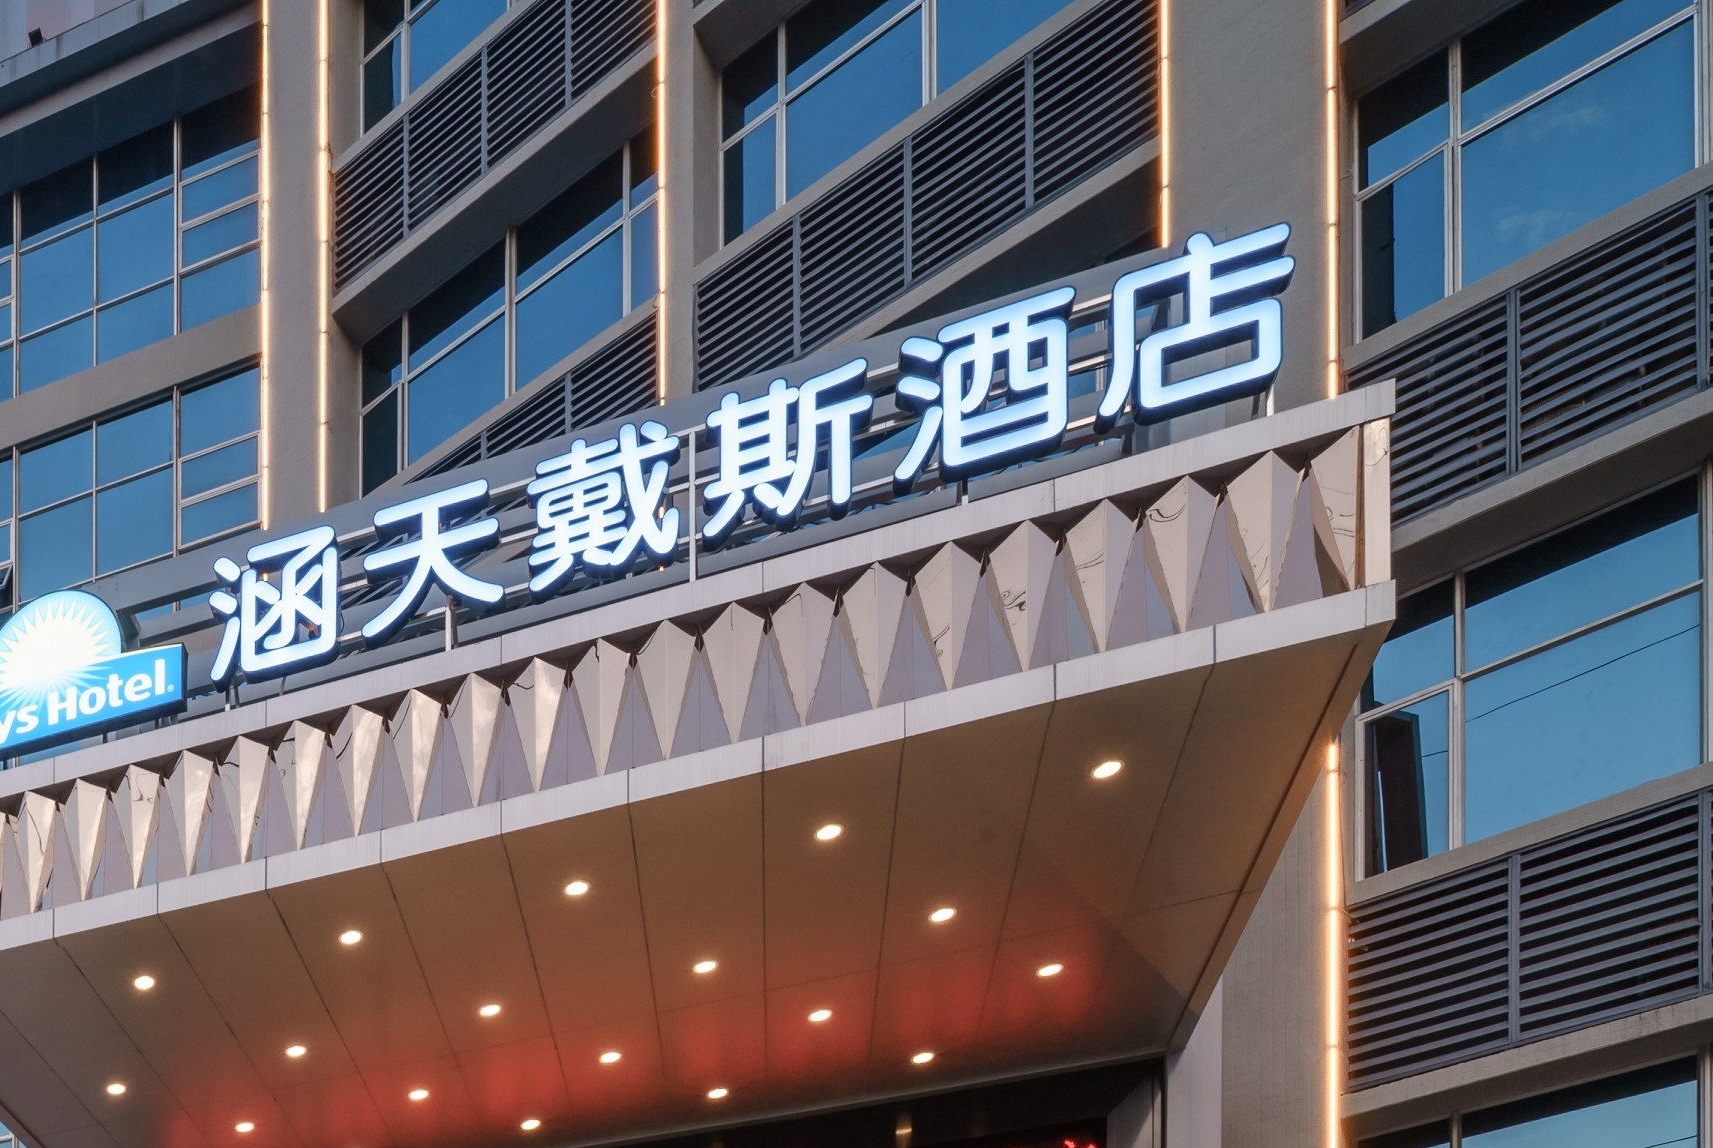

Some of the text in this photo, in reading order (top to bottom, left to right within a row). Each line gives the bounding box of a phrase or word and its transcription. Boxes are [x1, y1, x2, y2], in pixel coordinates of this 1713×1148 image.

[208, 222, 1297, 690] 涵天戴斯酒店
[47, 658, 166, 727] Hotel
